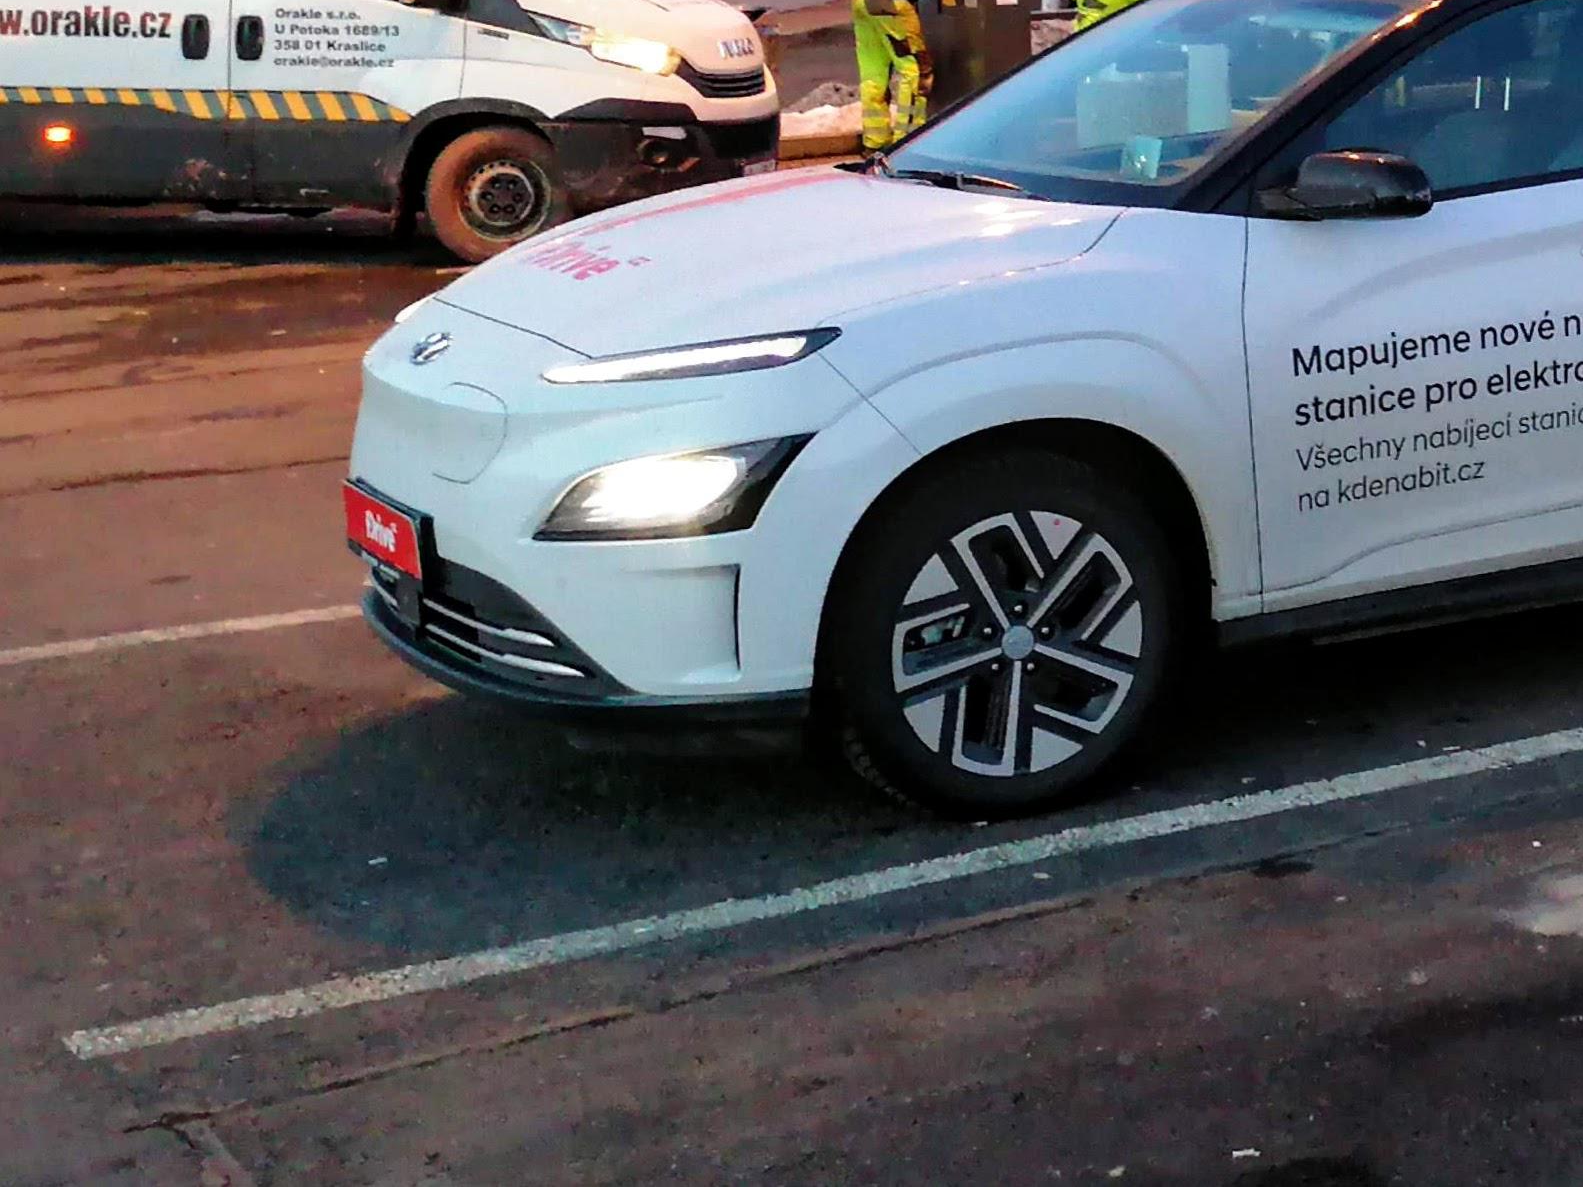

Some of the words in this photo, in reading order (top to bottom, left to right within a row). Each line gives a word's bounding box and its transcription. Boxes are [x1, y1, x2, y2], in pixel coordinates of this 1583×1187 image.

[0, 5, 172, 39] w.orakle.cz
[274, 23, 286, 34] U
[290, 24, 340, 35] Potoka
[275, 8, 322, 19] Orakle
[326, 10, 361, 20] s.r.o.
[274, 40, 300, 50] 358
[304, 40, 321, 50] 01
[326, 40, 386, 52] Kraslice
[1292, 331, 1471, 377] Mapujeme
[1480, 310, 1555, 349] nové
[1295, 384, 1416, 427] stanice
[1425, 376, 1478, 413] pro
[1296, 435, 1406, 472] Všechny
[1413, 411, 1512, 452] nabíjecí
[1298, 488, 1330, 512] na
[1337, 461, 1486, 504] kdenabit.cz
